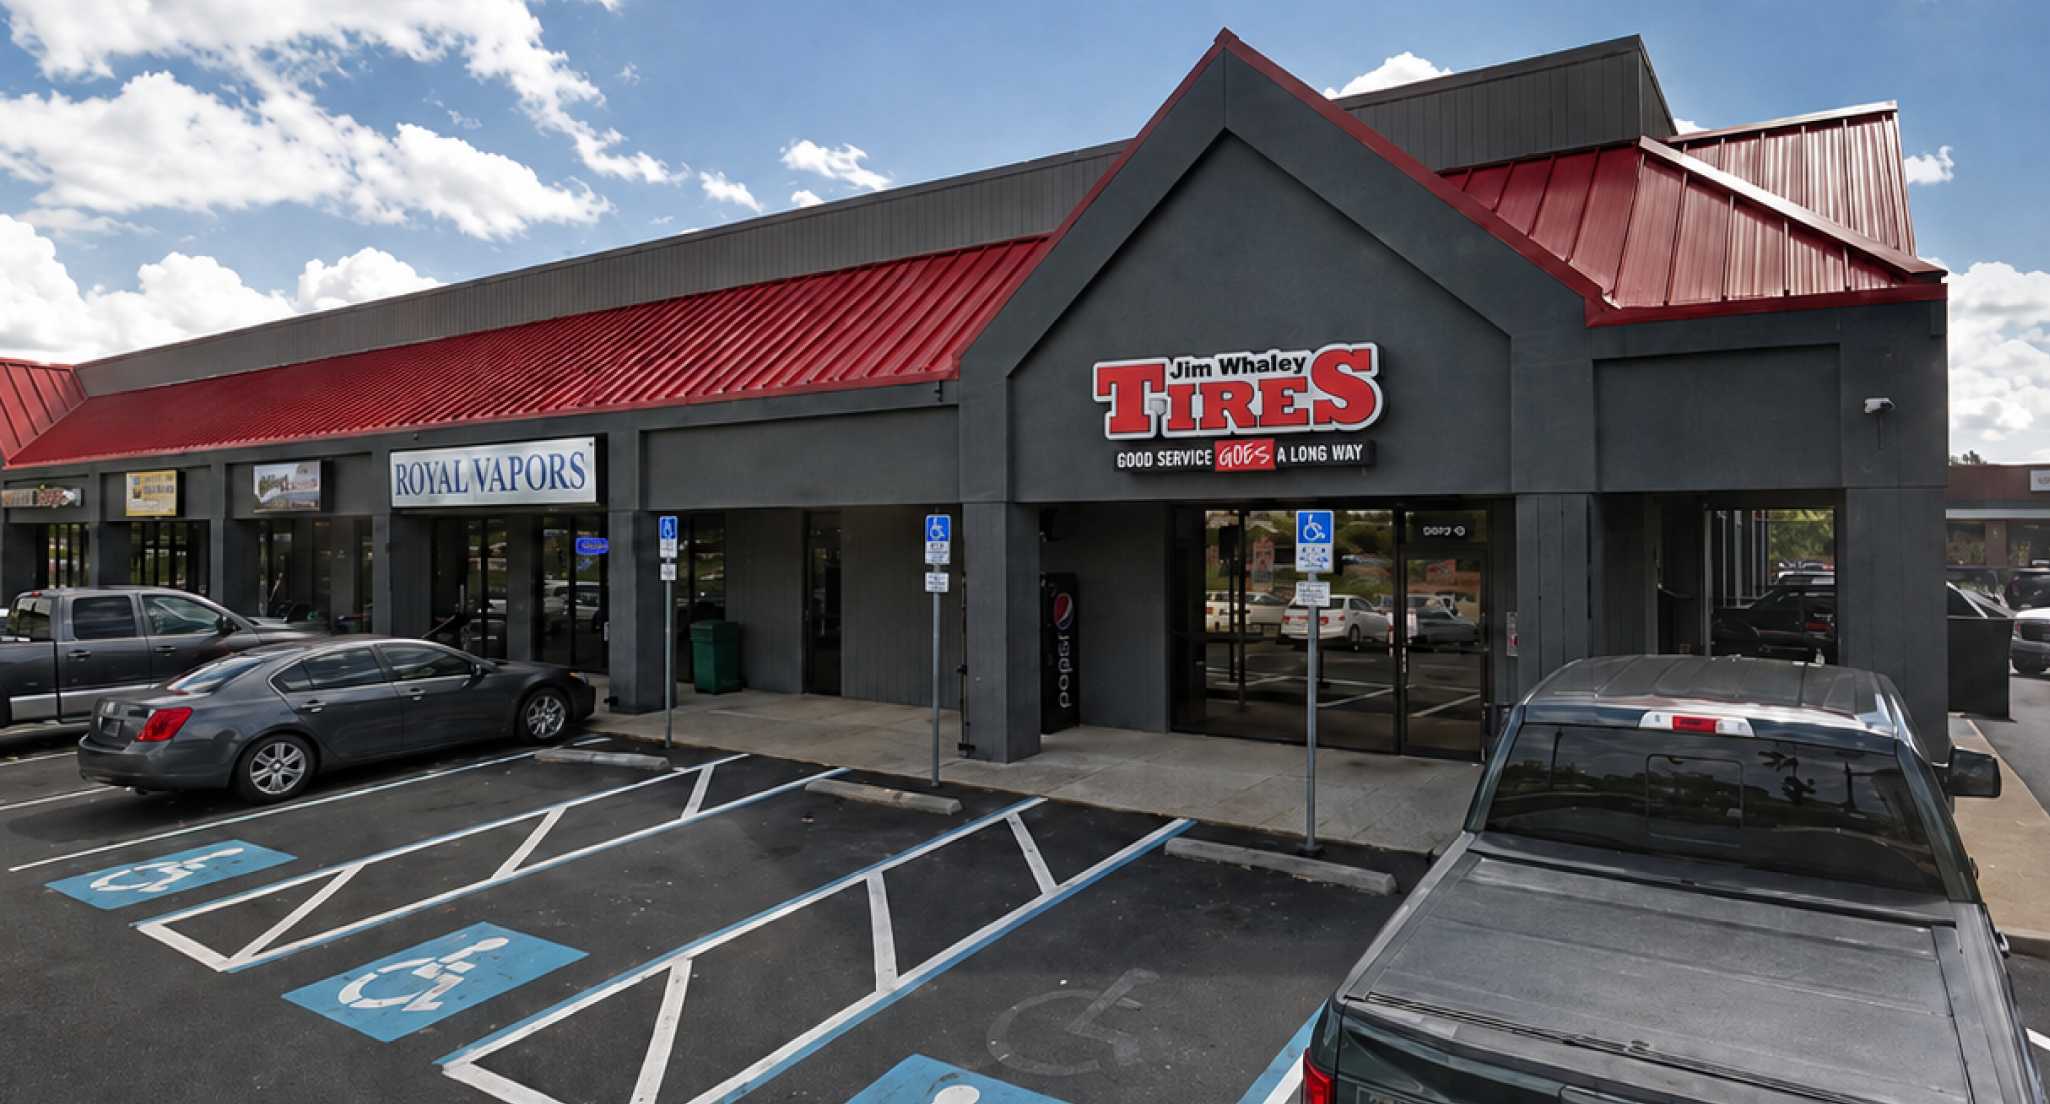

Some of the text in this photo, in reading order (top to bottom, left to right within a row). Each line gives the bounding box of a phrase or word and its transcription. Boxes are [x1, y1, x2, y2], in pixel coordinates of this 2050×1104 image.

[1170, 355, 1307, 379] Jim Whaley
[1096, 348, 1378, 434] TIRES
[395, 451, 586, 496] ROYAL VAPORS
[1117, 443, 1363, 469] GOOD SERVICE GOES A LONG WAY
